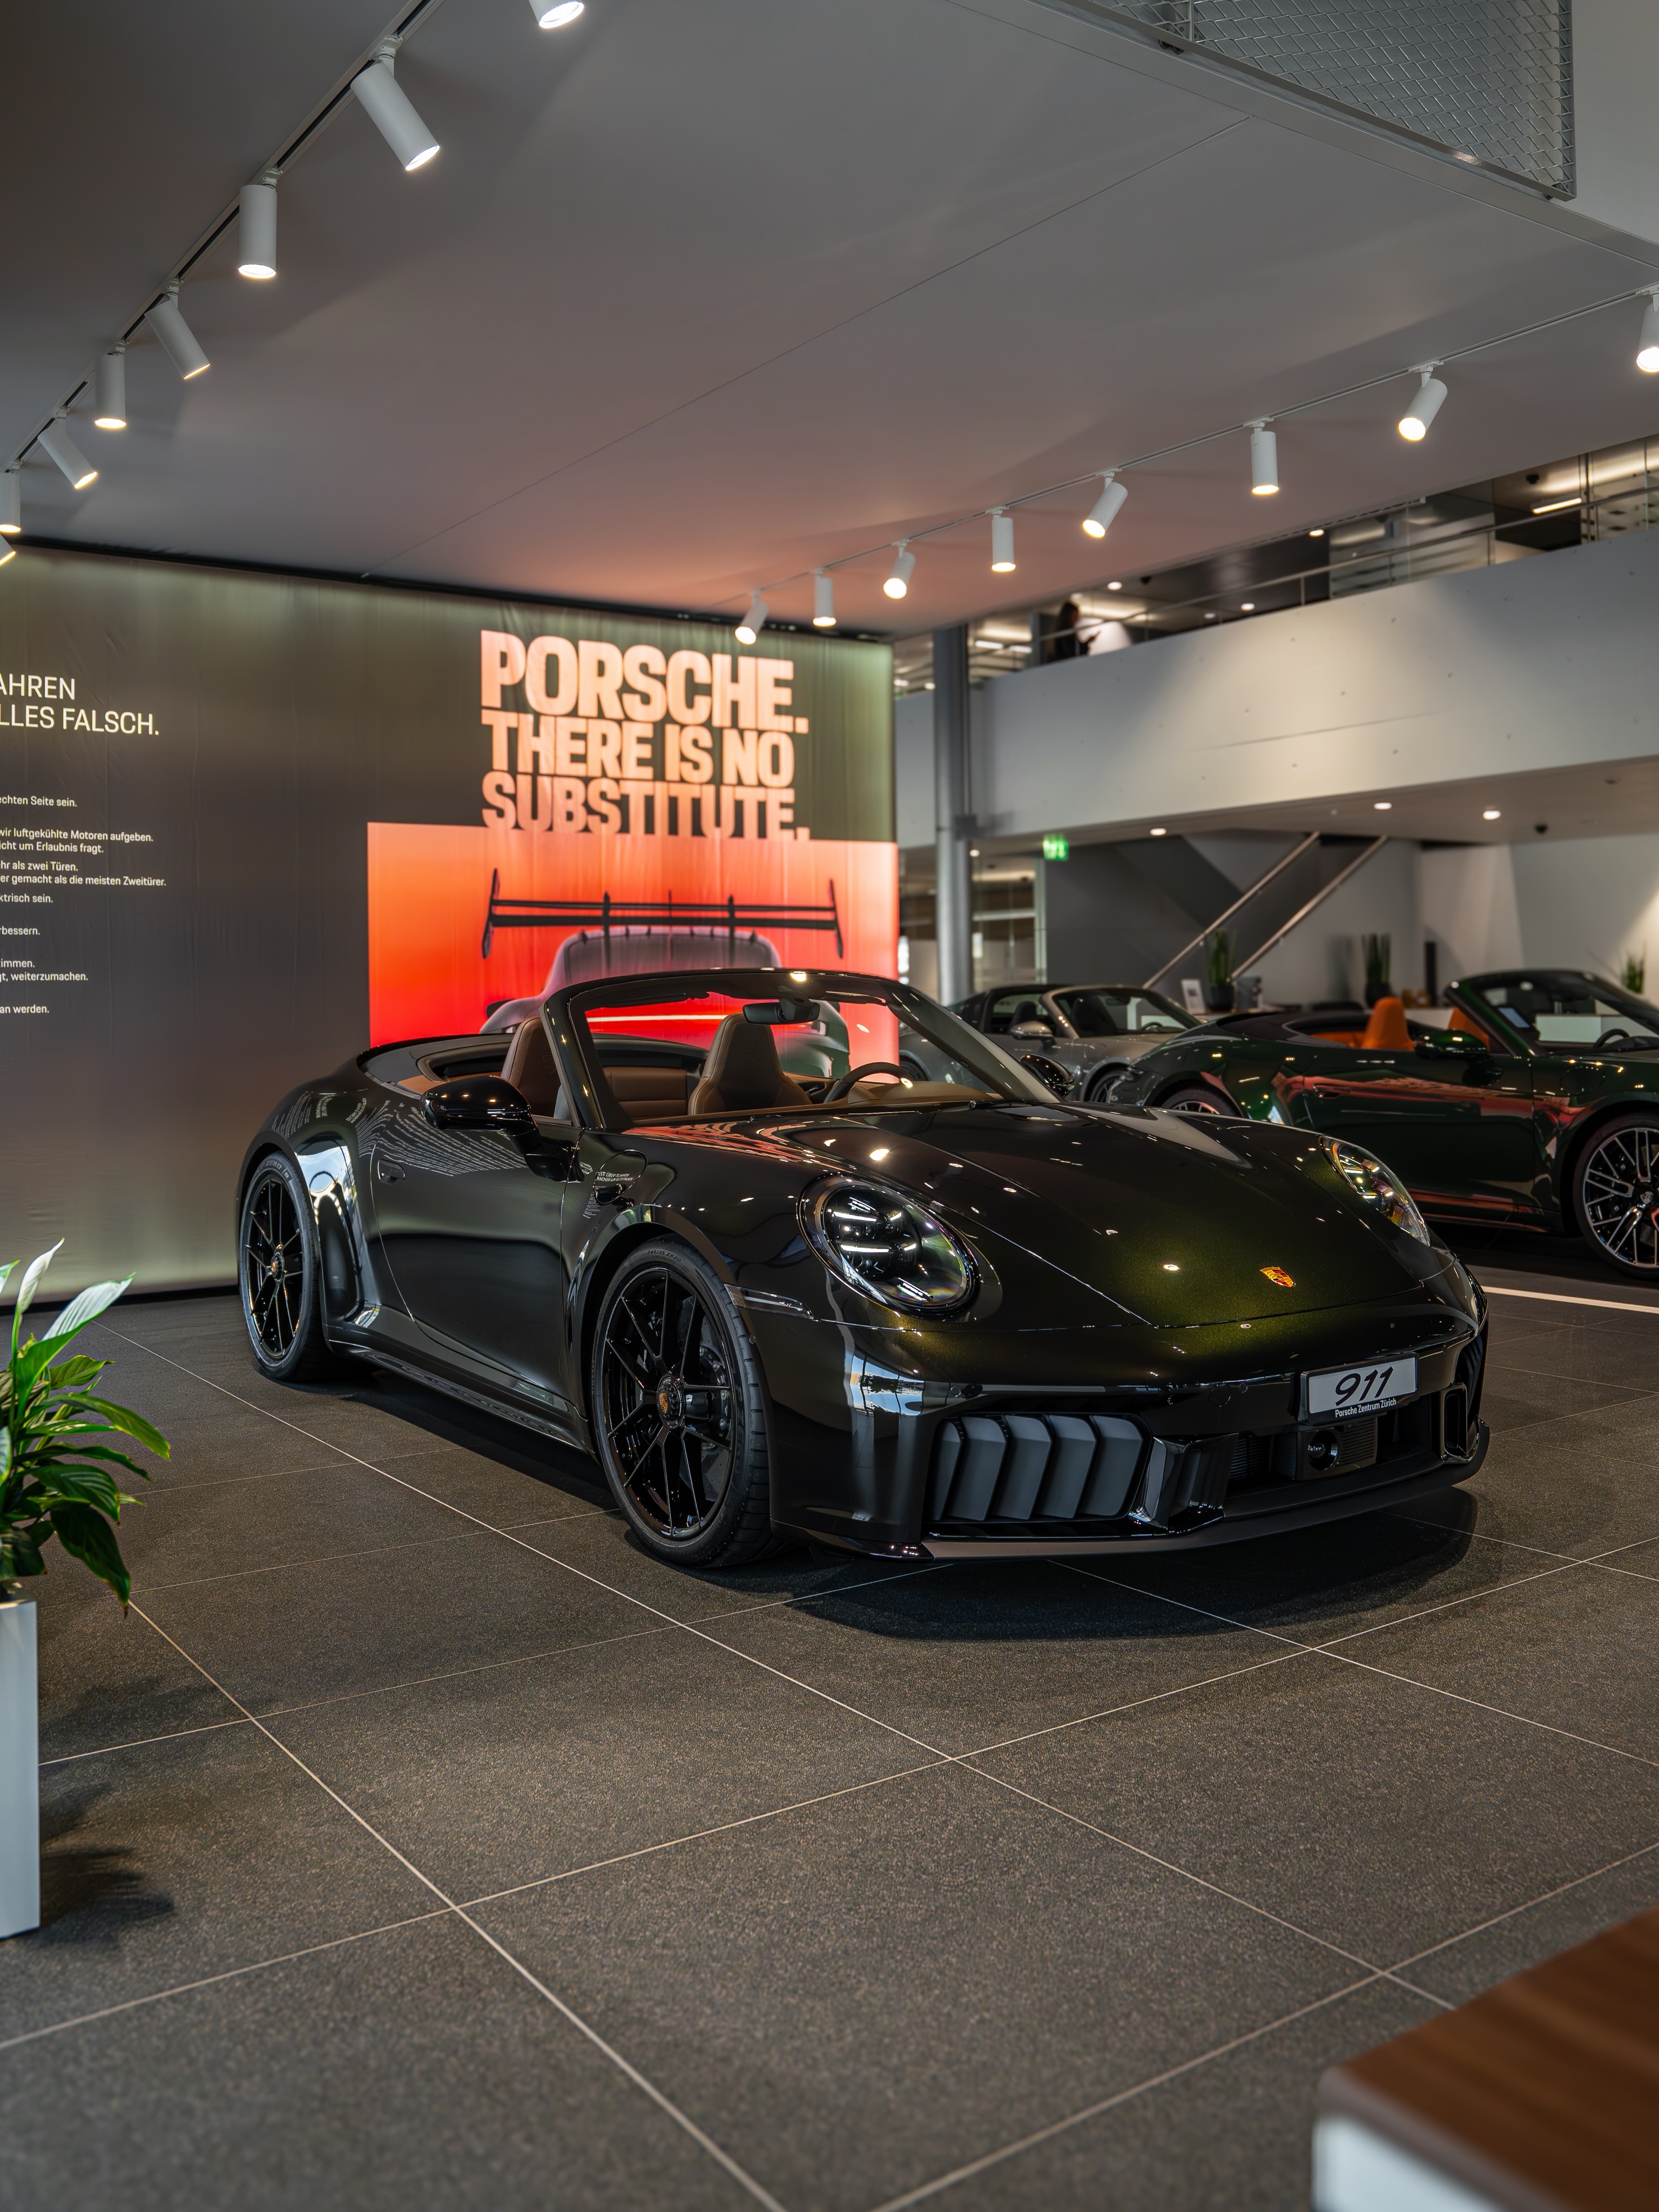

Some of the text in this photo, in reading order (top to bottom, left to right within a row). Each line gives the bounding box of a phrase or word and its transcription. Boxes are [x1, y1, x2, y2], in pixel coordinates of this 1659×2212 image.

[481, 630, 809, 734] PORSCHE.
[63, 707, 159, 736] FALSCH.
[481, 709, 794, 788] THERE IS NO
[0, 794, 77, 807] chten Seite sein.
[482, 770, 810, 841] SUBSTITUTE.
[14, 827, 69, 840] luftgekühlte
[70, 830, 108, 840] Motoren
[110, 831, 153, 844] aufgeben.
[36, 841, 78, 852] Erlaubnis
[79, 842, 104, 855] fragt.
[0, 860, 78, 872] hr als zwei Türen.
[11, 874, 52, 885] gemacht
[54, 874, 67, 884] als
[69, 875, 83, 885] die
[85, 875, 121, 885] meisten
[123, 876, 166, 886] Zweitürer.
[32, 893, 53, 903] sein.
[10, 972, 89, 981] weiterzumachen.
[12, 1003, 50, 1014] werden.
[1335, 1366, 1394, 1407] 911
[1335, 1397, 1397, 1418] Porsche Zentrum Zürich
